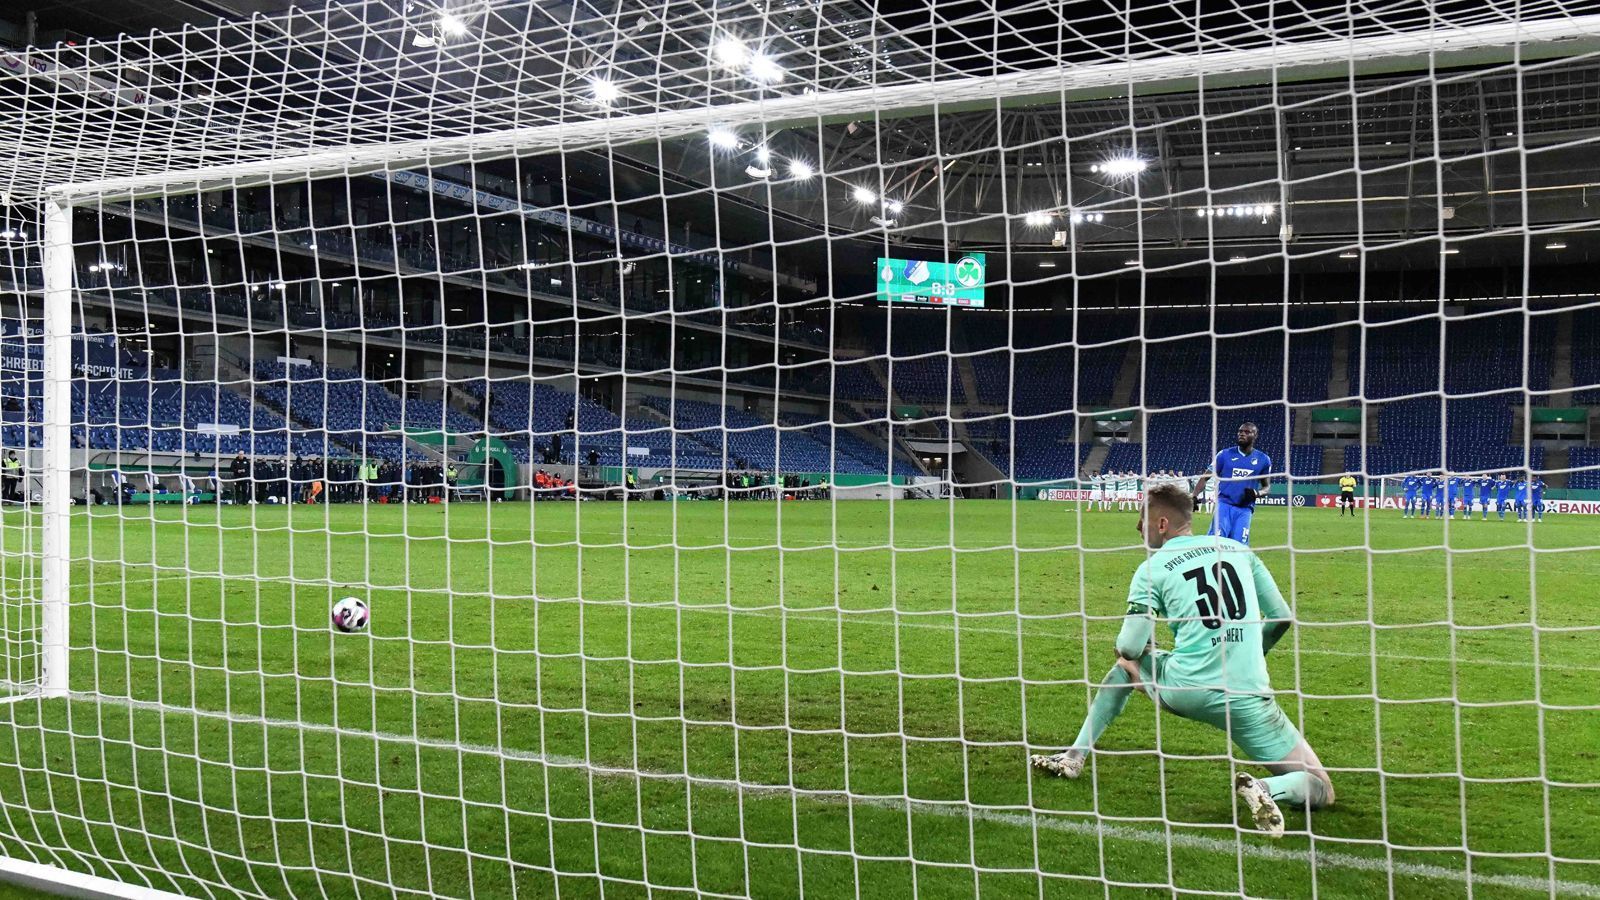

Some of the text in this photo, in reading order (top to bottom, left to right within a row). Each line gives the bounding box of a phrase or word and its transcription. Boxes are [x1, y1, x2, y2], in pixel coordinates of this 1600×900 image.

[395, 171, 409, 183] SAP
[434, 181, 448, 193] SAP
[453, 186, 467, 198] SAP
[1232, 468, 1249, 478] SAP
[1182, 560, 1247, 630] 30
